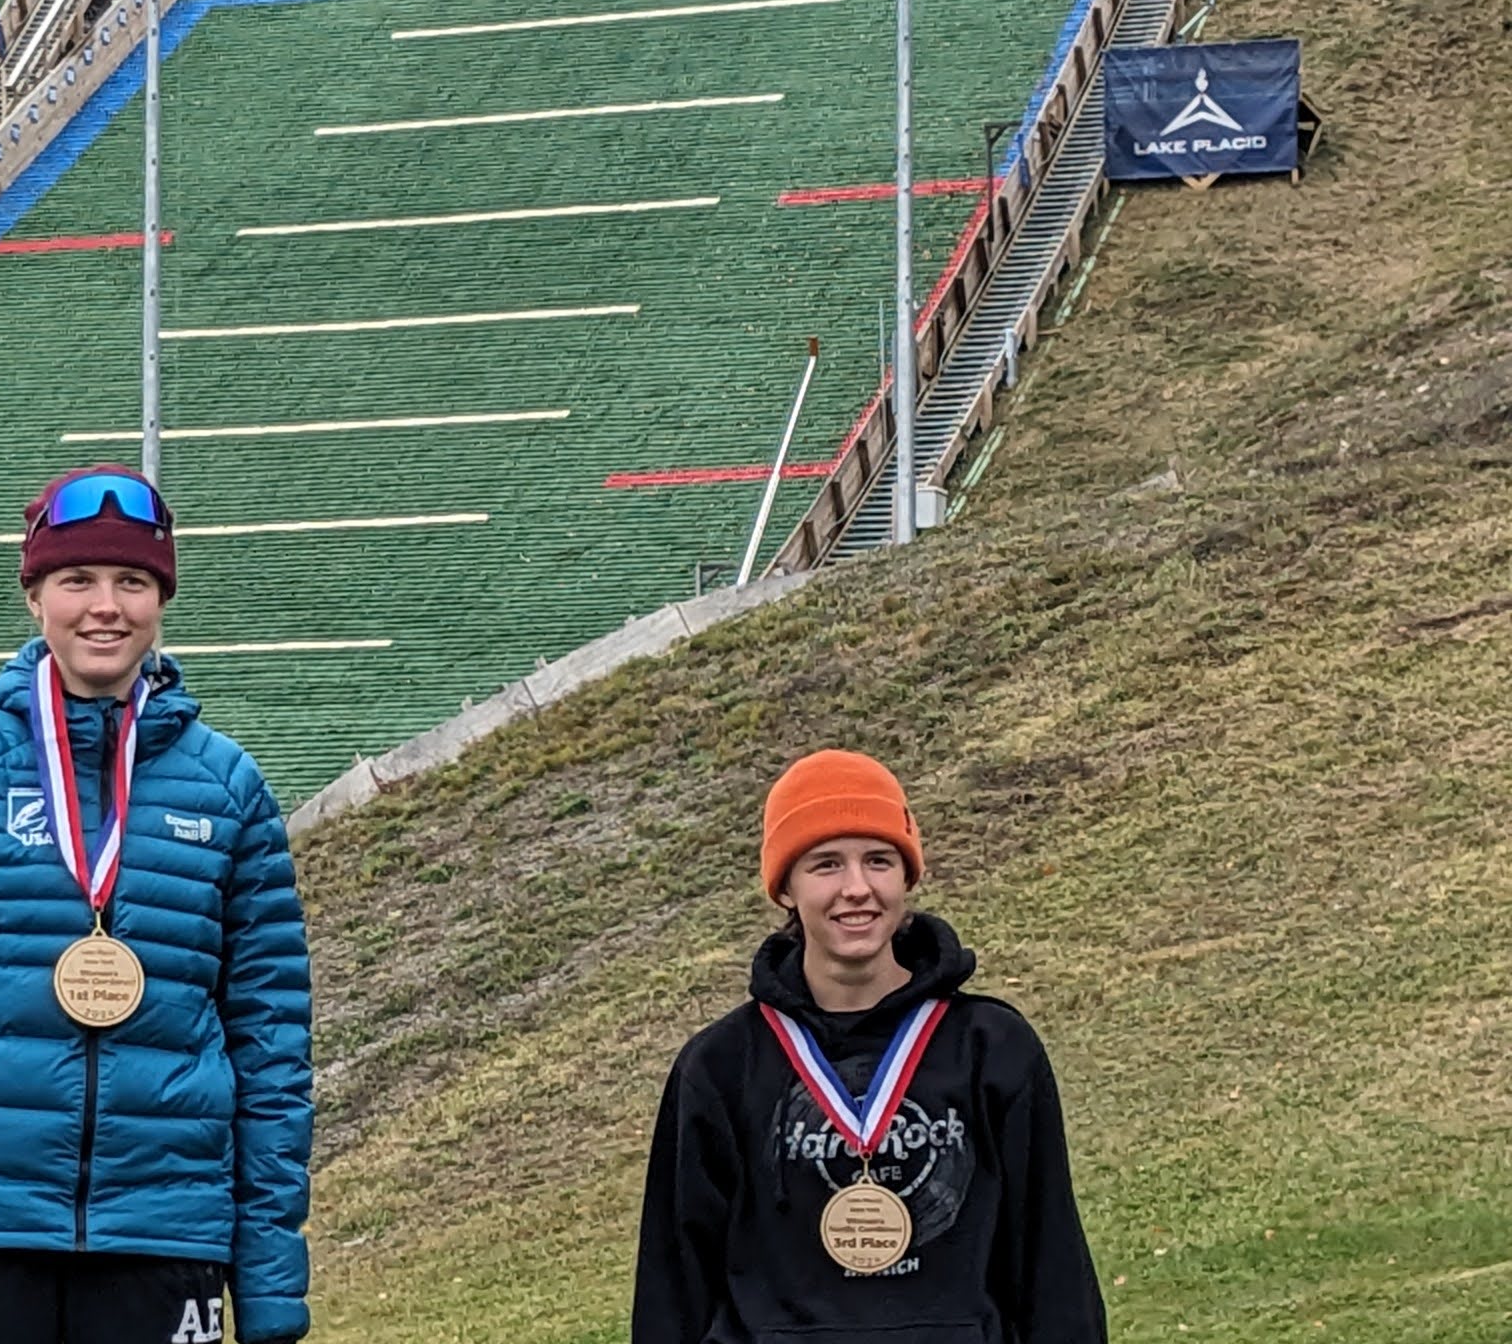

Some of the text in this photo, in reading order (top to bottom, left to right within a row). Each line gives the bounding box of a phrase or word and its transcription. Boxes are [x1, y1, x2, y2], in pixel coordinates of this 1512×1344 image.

[1133, 135, 1267, 156] LAKE PLACID
[21, 833, 55, 846] USA
[70, 989, 130, 1002] 1st Place
[877, 1107, 965, 1161] Rock
[833, 1237, 898, 1249] 3rd Place
